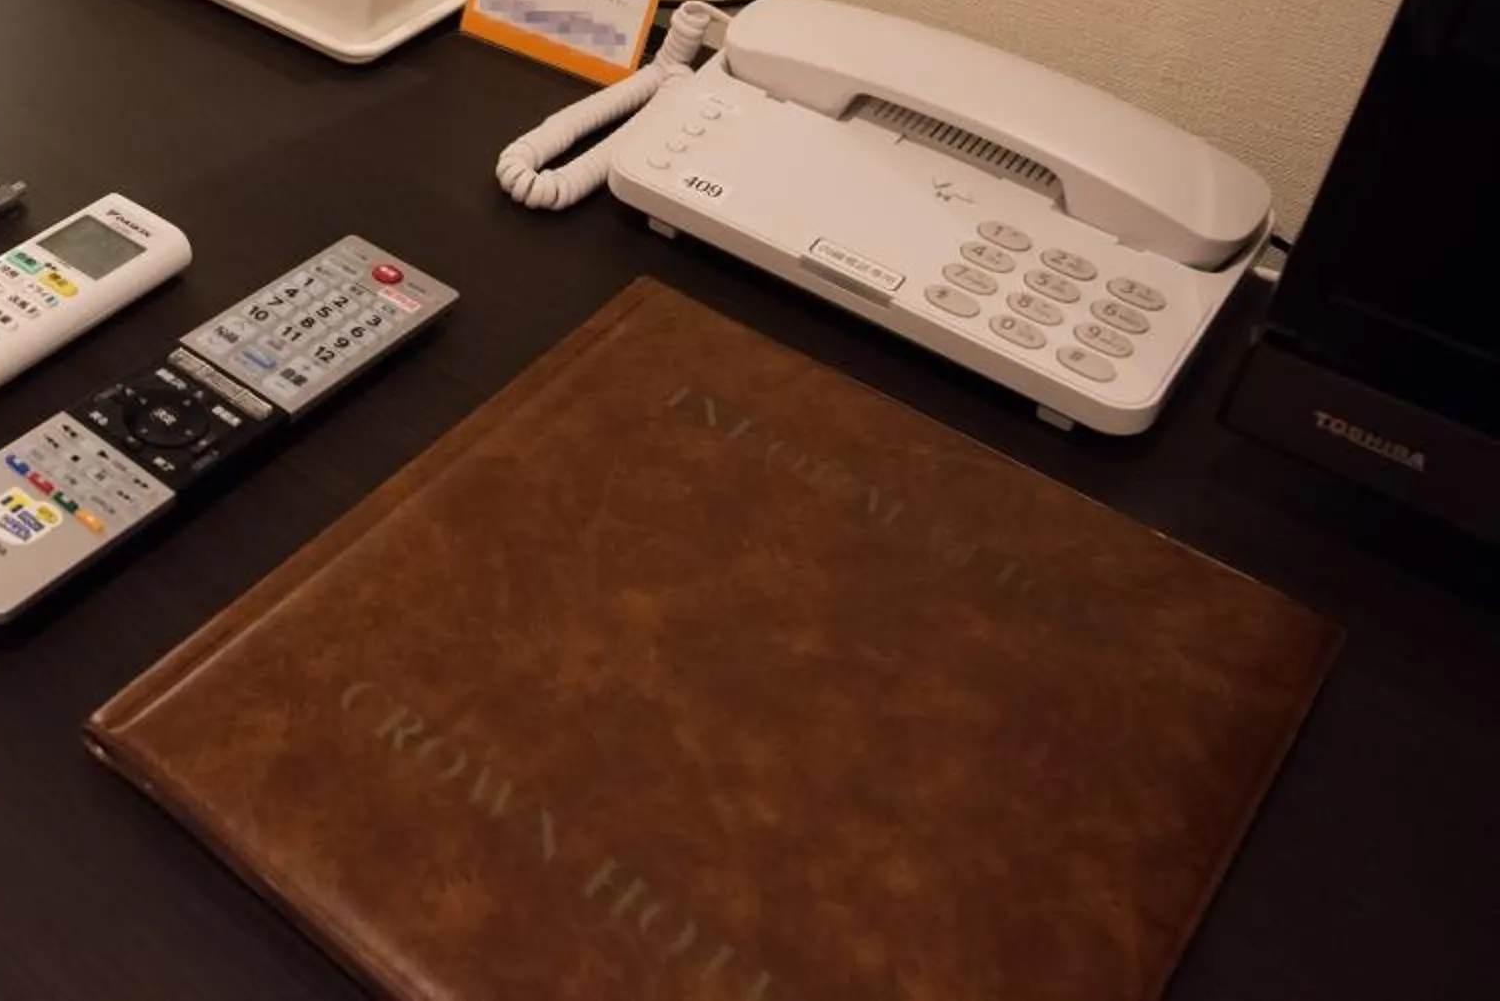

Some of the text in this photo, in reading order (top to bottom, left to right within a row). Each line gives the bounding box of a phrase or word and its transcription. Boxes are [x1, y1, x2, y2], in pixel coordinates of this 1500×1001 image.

[683, 175, 724, 198] 409
[303, 277, 314, 288] 1
[285, 287, 299, 299] 4
[268, 296, 284, 308] 7
[333, 296, 349, 308] 2
[250, 305, 269, 322] 10
[317, 306, 333, 319] 5
[301, 316, 315, 329] 8
[366, 315, 382, 328] 3
[282, 325, 302, 342] 11
[351, 326, 366, 338] 6
[334, 336, 350, 350] 9
[314, 346, 336, 363] 12
[1313, 409, 1426, 472] TOSHIBA
